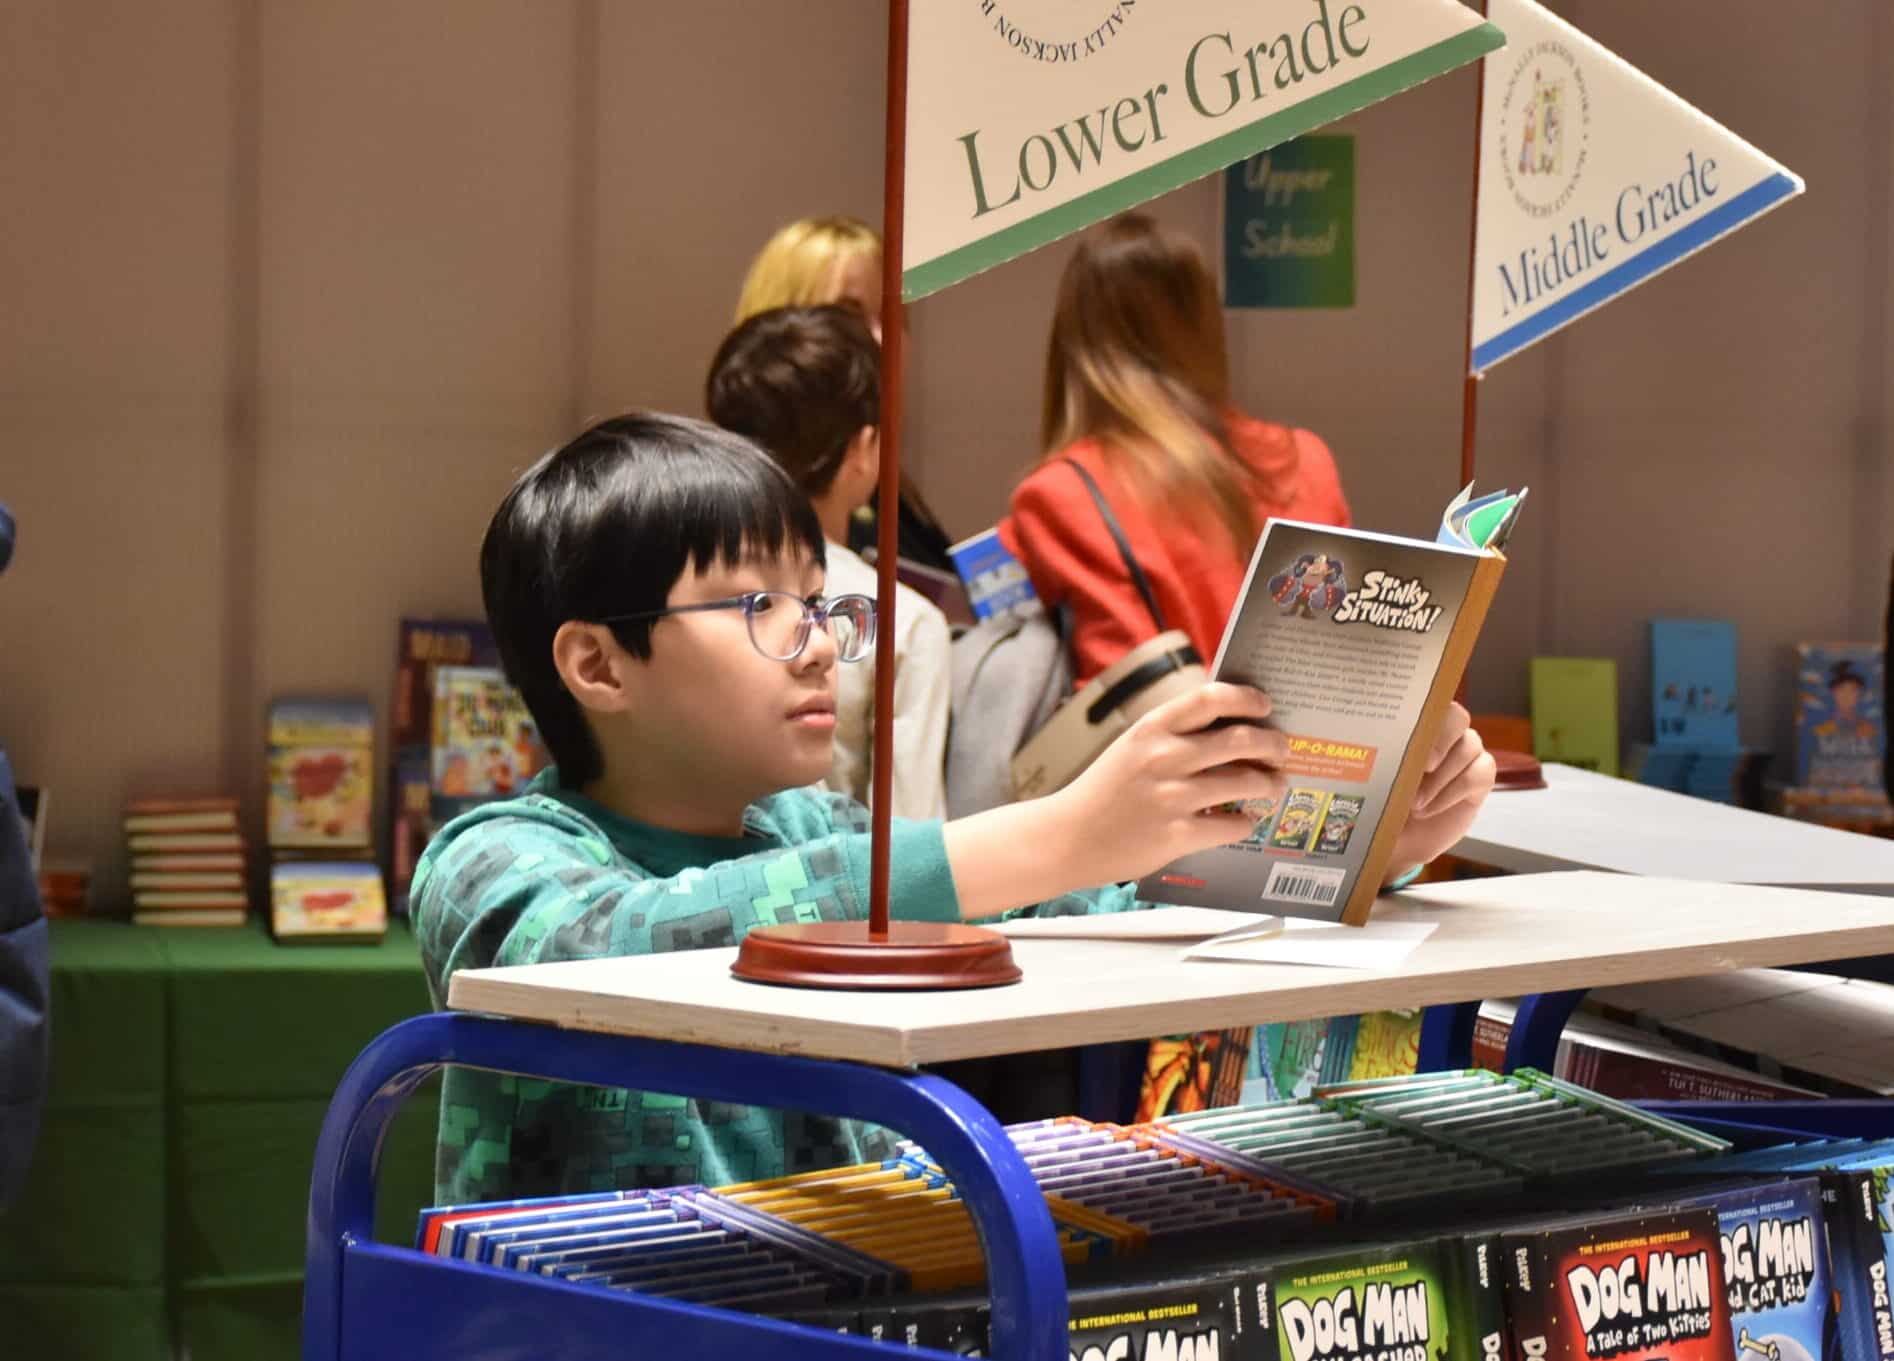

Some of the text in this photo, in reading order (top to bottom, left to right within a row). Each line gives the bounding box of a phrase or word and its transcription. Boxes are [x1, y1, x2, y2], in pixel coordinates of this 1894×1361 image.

[994, 15, 1077, 63] JACKSON
[956, 83, 1168, 220] Lower
[1184, 0, 1371, 119] Grade
[1241, 218, 1340, 259] School
[1497, 217, 1609, 317] Middle
[1615, 151, 1719, 245] Grade
[1579, 1231, 1690, 1255] THE INTERNATIONAL BESTSELLER
[1758, 1218, 1815, 1278] MAN
[1293, 1260, 1408, 1287] THE INTERNATIONAL BESTSELLER
[1567, 1251, 1710, 1334] DOG MAN
[1749, 1279, 1777, 1308] CAT
[1869, 1260, 1889, 1307] DOG
[1079, 1309, 1146, 1329] INTERNATIONAL
[1148, 1303, 1198, 1320] BESTSELLER
[1280, 1288, 1359, 1361] DOG
[1363, 1282, 1429, 1346] MAN
[1587, 1333, 1596, 1352] A
